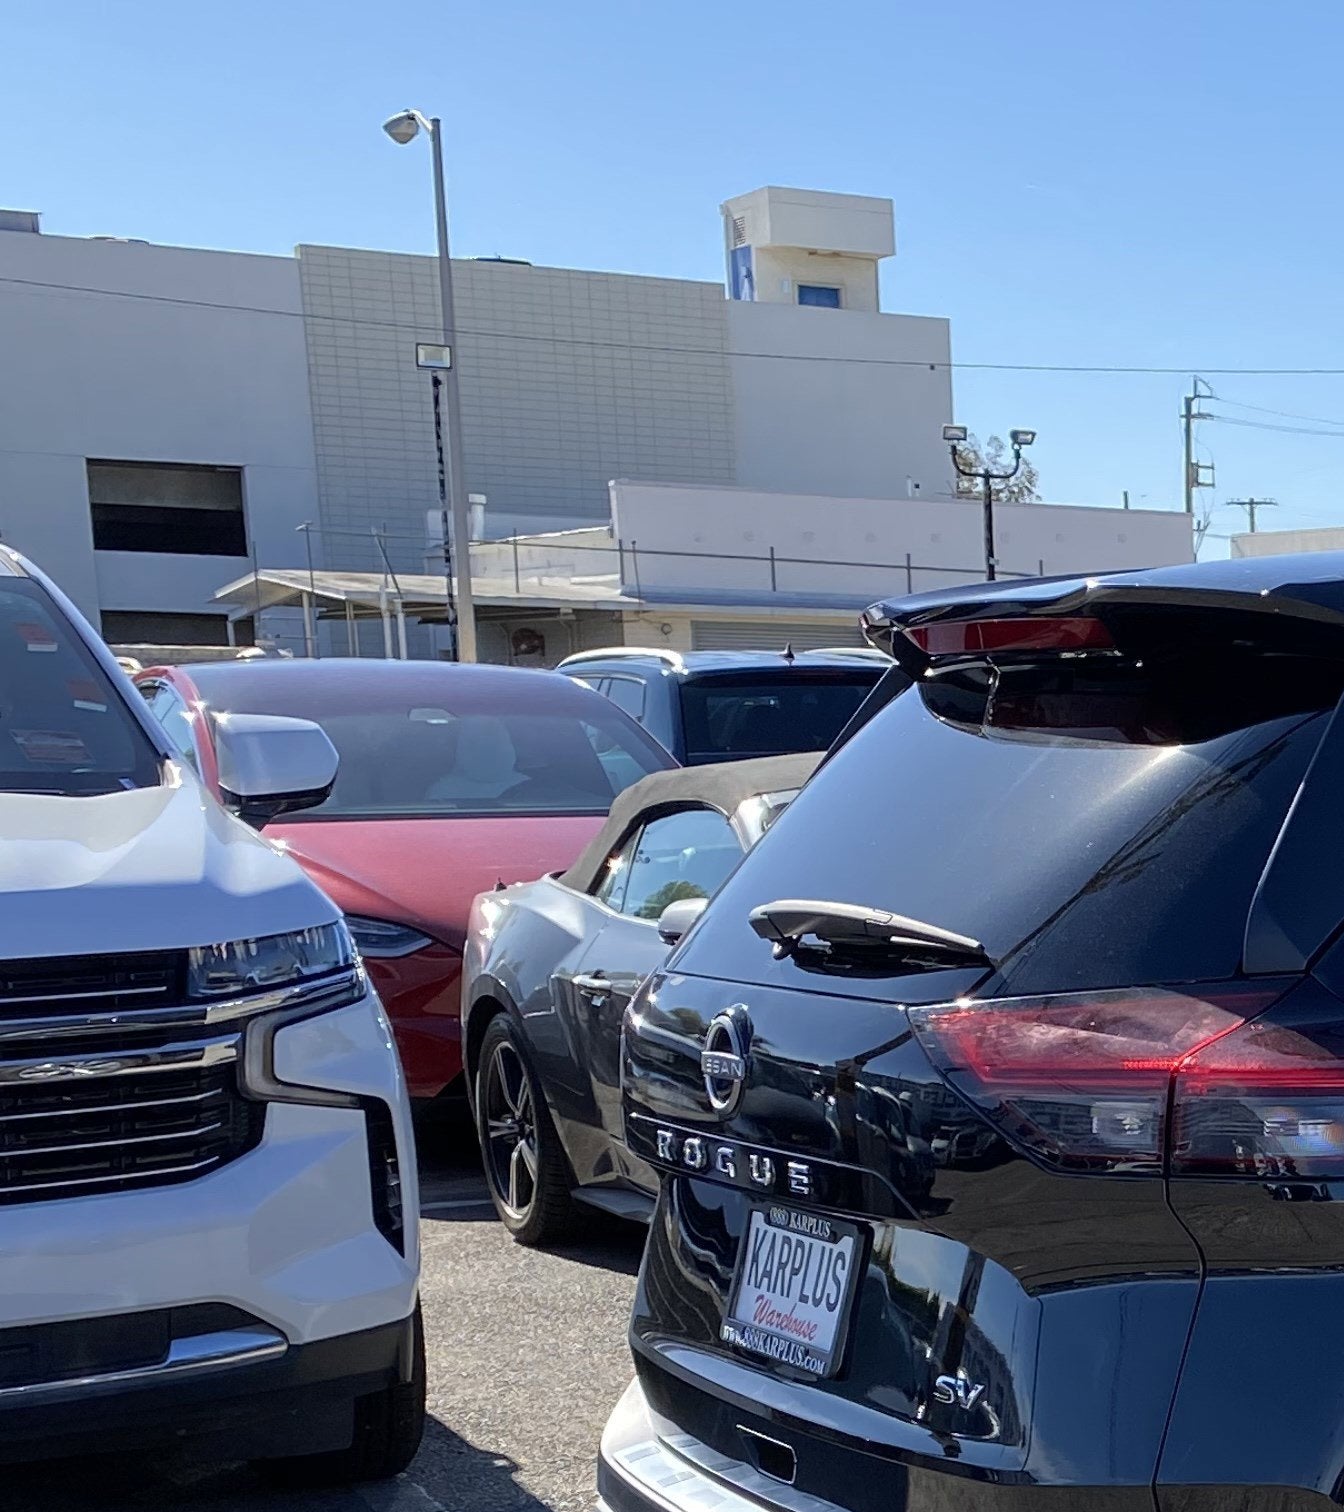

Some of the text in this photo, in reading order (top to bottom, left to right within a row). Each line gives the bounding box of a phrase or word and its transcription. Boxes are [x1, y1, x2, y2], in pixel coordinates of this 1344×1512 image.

[656, 1129, 810, 1195] ROGUE
[789, 1211, 832, 1239] KARPLUS
[746, 1226, 847, 1313] KARPLUS
[752, 1293, 818, 1342] Warehouse
[932, 1374, 985, 1411] SV
